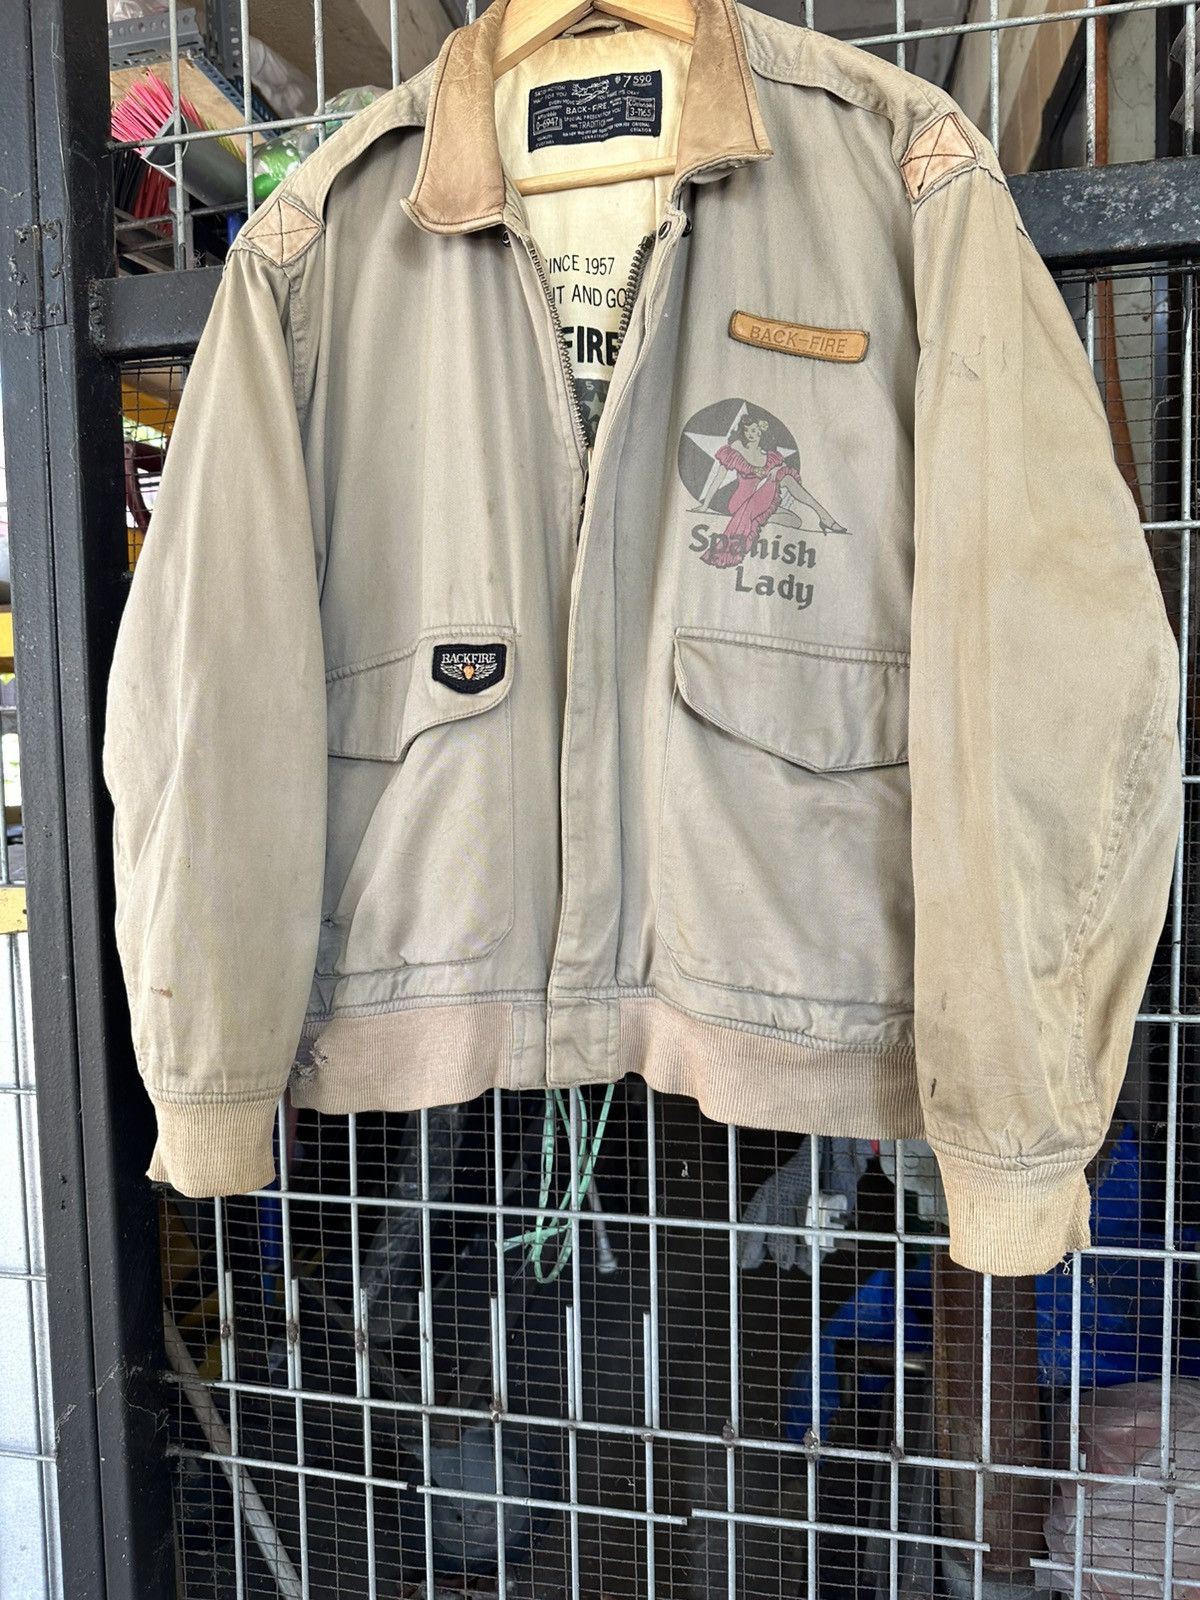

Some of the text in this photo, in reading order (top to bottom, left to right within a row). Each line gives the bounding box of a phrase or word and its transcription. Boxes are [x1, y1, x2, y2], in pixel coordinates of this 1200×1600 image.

[632, 74, 652, 84] 590
[545, 254, 615, 276] INCE 1957
[571, 284, 602, 307] AND
[749, 325, 848, 354] BACK-FIRE
[688, 523, 817, 569] Spanish
[734, 565, 815, 611] Lady
[440, 652, 497, 664] BACKFIRE
